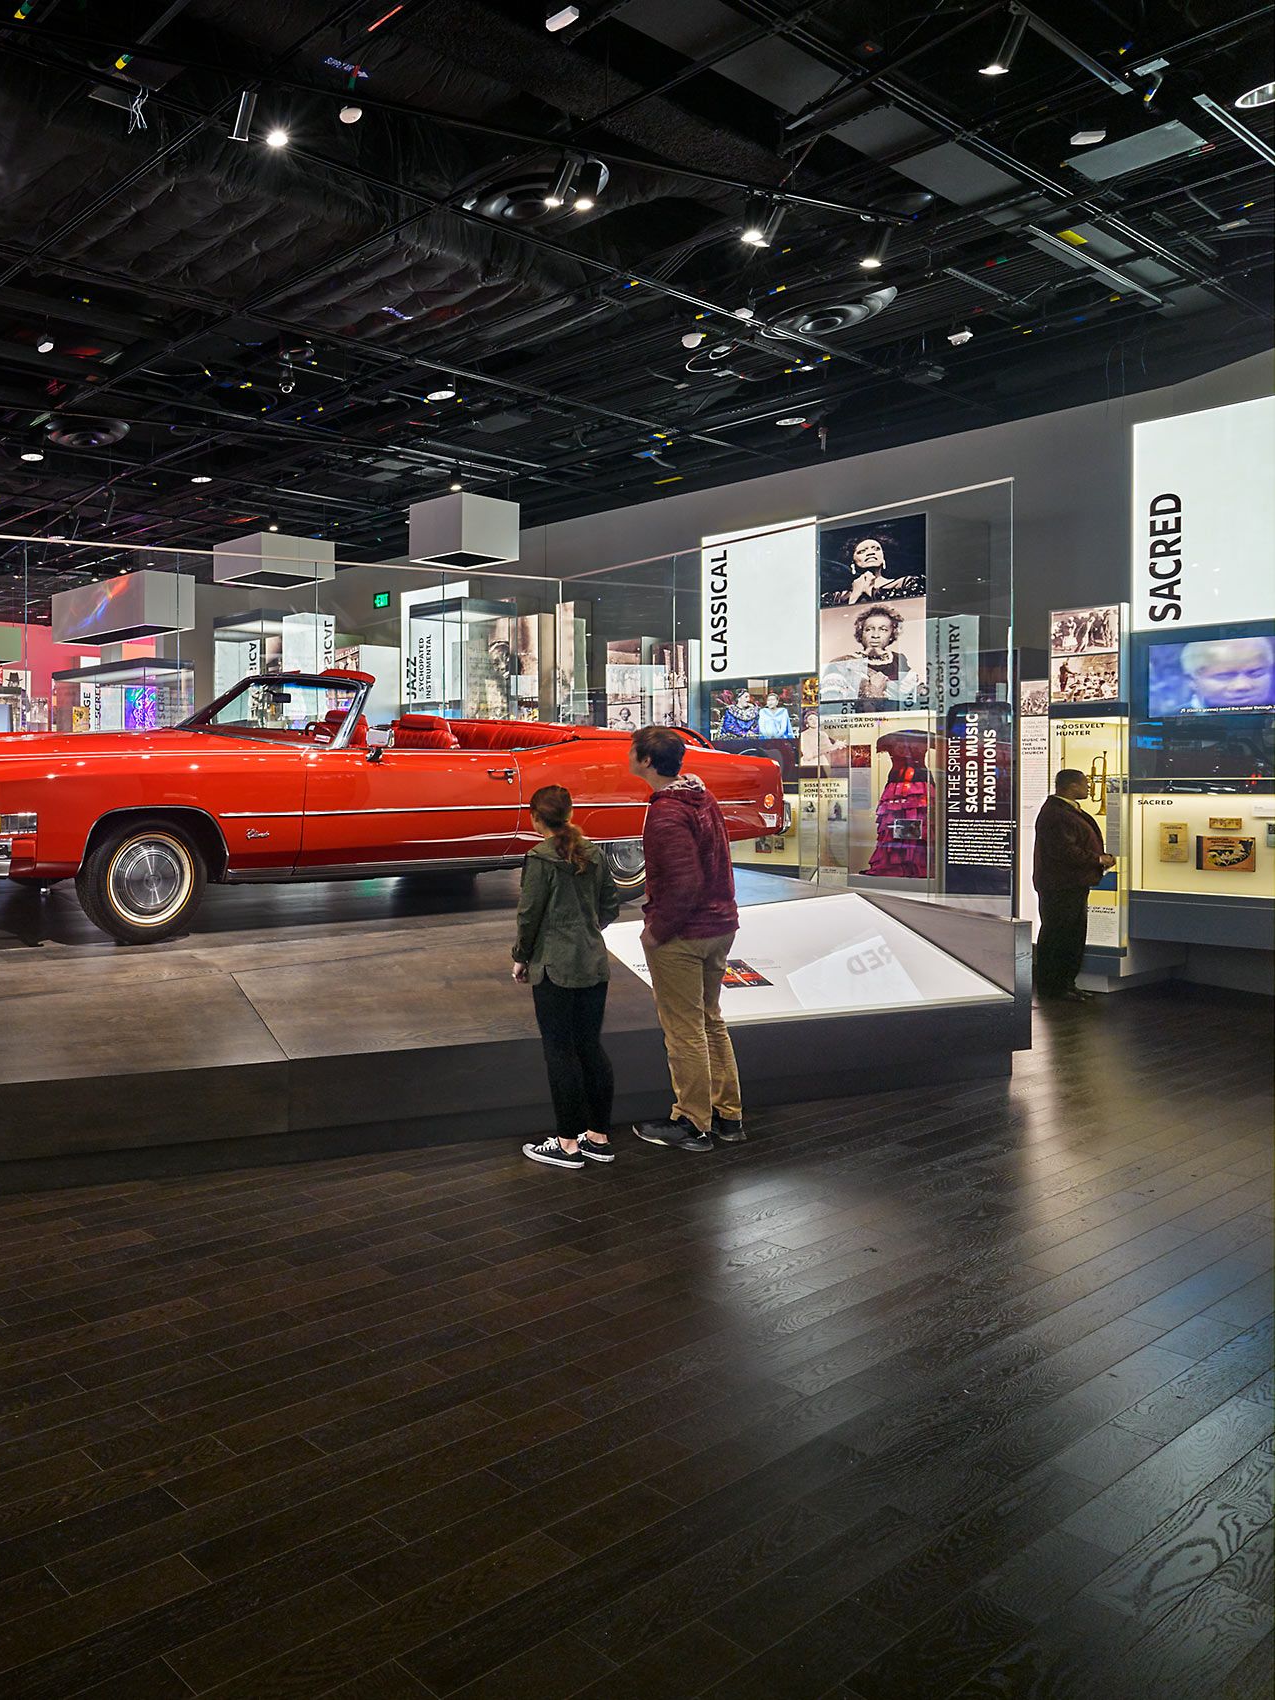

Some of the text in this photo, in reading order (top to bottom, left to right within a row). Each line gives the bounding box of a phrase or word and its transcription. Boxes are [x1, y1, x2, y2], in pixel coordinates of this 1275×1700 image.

[1149, 493, 1182, 622] SACRED
[711, 549, 728, 673] CLASSICAL
[406, 656, 417, 700] JAZZ
[948, 623, 960, 698] COUNTRY
[965, 713, 979, 813] SACRED MUSIC
[1056, 722, 1105, 730] ROOSEVELT
[948, 736, 961, 813] IN THE SPIRIT:
[983, 729, 997, 813] TRADITIONS
